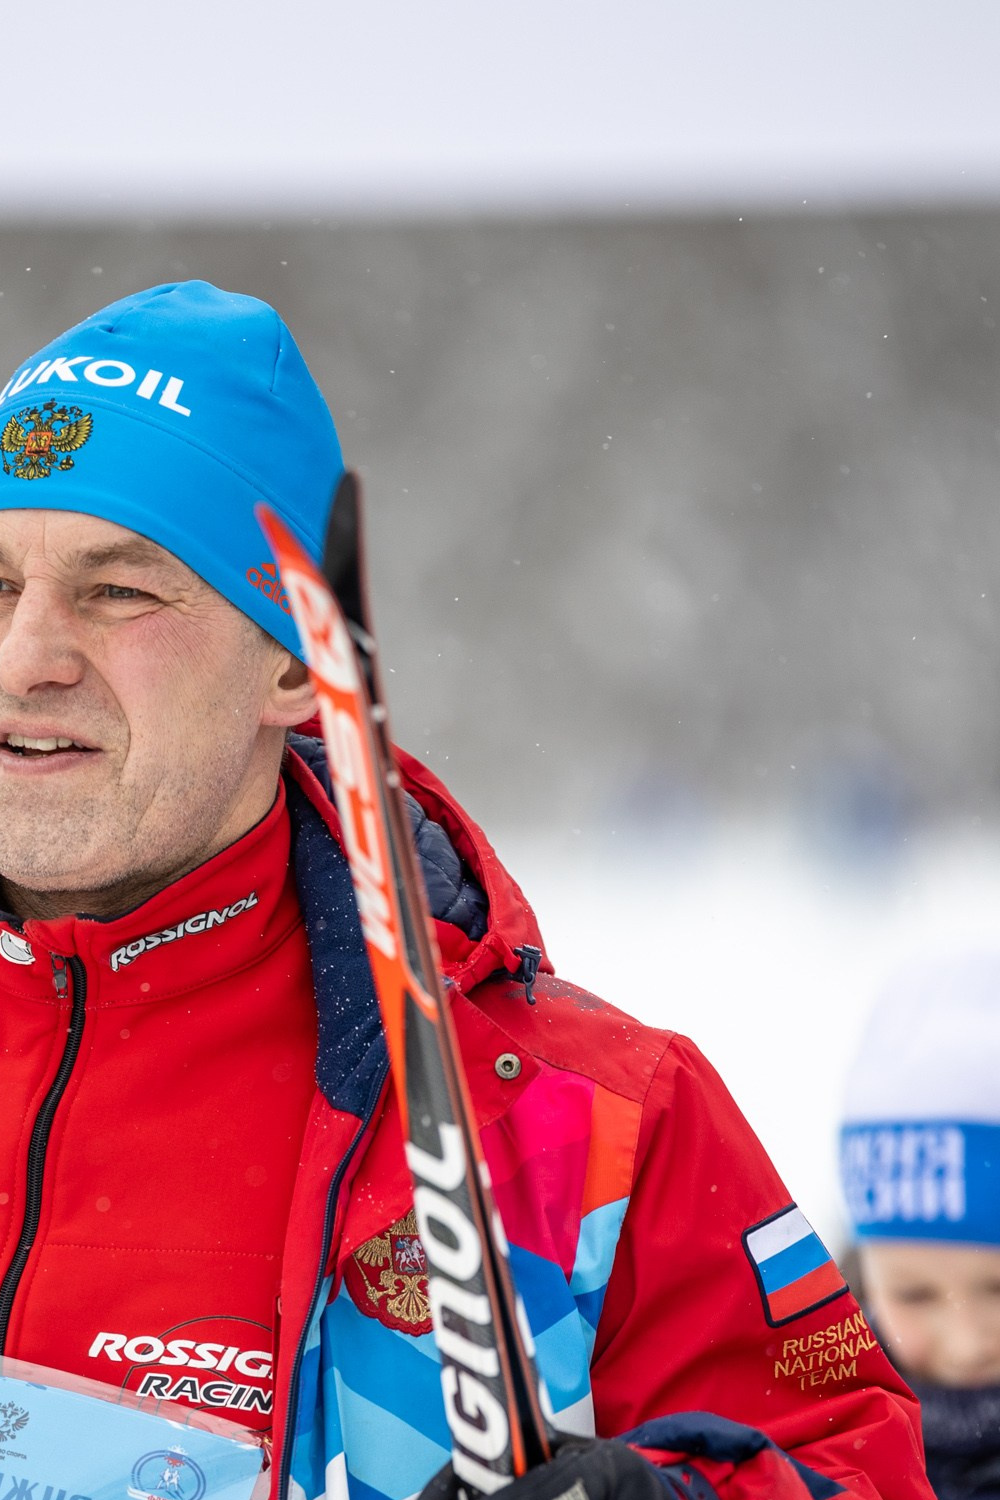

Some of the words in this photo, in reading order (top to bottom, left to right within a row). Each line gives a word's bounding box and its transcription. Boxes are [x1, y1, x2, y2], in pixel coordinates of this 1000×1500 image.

[110, 892, 259, 972] ROSSIGNOL
[88, 1331, 273, 1378] ROSSIG
[774, 1330, 878, 1379] NATIONAL
[782, 1309, 868, 1358] RUSSIAN
[135, 1372, 273, 1415] RACIN
[798, 1359, 858, 1391] TEAM
